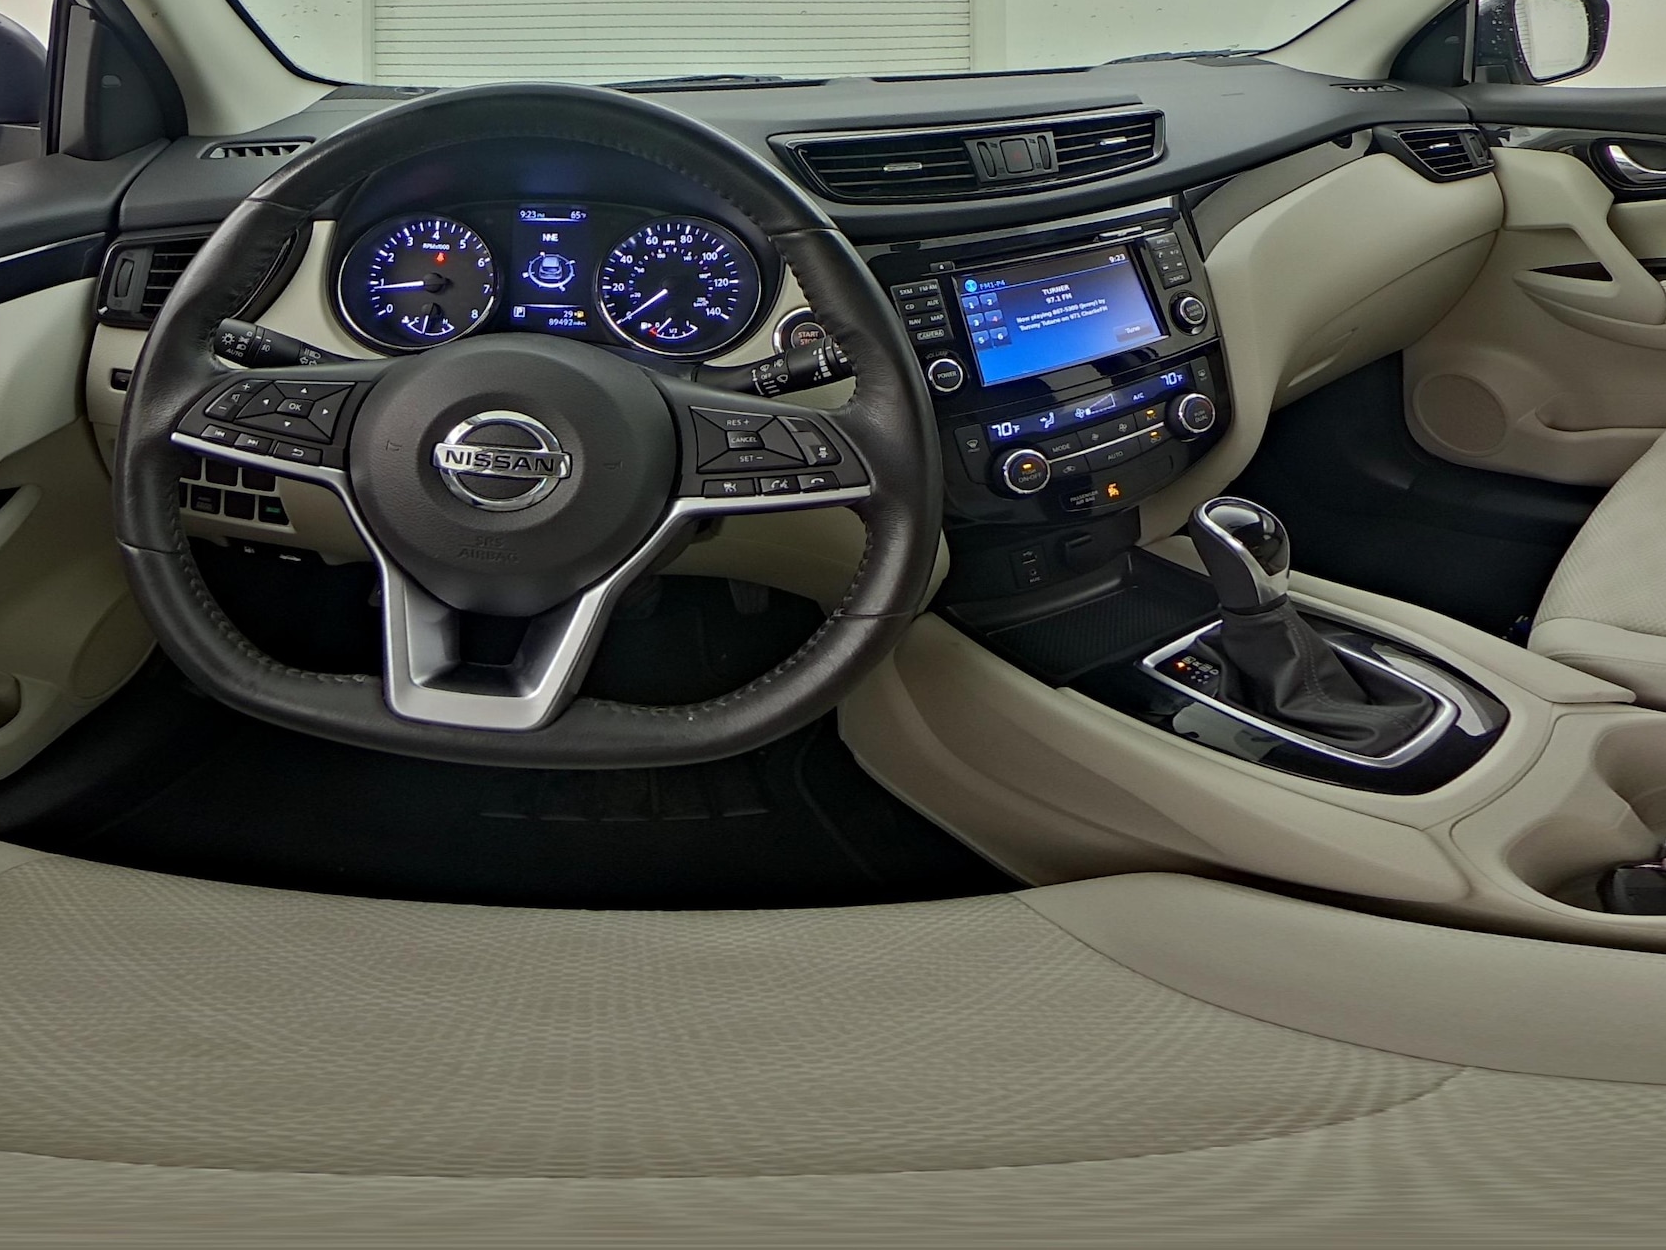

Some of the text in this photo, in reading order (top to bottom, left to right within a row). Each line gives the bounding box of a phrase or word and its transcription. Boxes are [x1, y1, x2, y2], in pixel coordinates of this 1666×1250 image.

[432, 231, 440, 240] 4
[542, 233, 559, 242] NNE
[680, 235, 693, 244] 80
[407, 237, 414, 246] 3
[459, 240, 466, 249] 5
[645, 236, 659, 246] 60
[387, 253, 395, 262] 2
[619, 254, 633, 264] 40
[702, 251, 718, 261] 100
[1108, 253, 1126, 264] 9:23
[477, 258, 485, 267] 6
[714, 277, 729, 287] 120
[483, 284, 491, 293] 7
[612, 282, 625, 292] 20
[1041, 284, 1071, 296] TURNER
[926, 299, 940, 307] AUX
[987, 298, 993, 306] 2
[1045, 292, 1073, 305] 97.1 FM
[386, 304, 394, 313] 0
[705, 306, 722, 316] 140
[471, 310, 479, 318] 8
[563, 310, 573, 318] 29
[930, 314, 944, 322] MAP
[974, 319, 980, 327] 3
[978, 336, 985, 344] 5
[225, 348, 244, 358] AUTO
[937, 371, 957, 379] POWER
[1133, 392, 1145, 401] A/C
[288, 403, 302, 411] OK
[1052, 443, 1071, 453] MODE
[1107, 451, 1124, 460] AUTO
[445, 449, 554, 472] NISSAN
